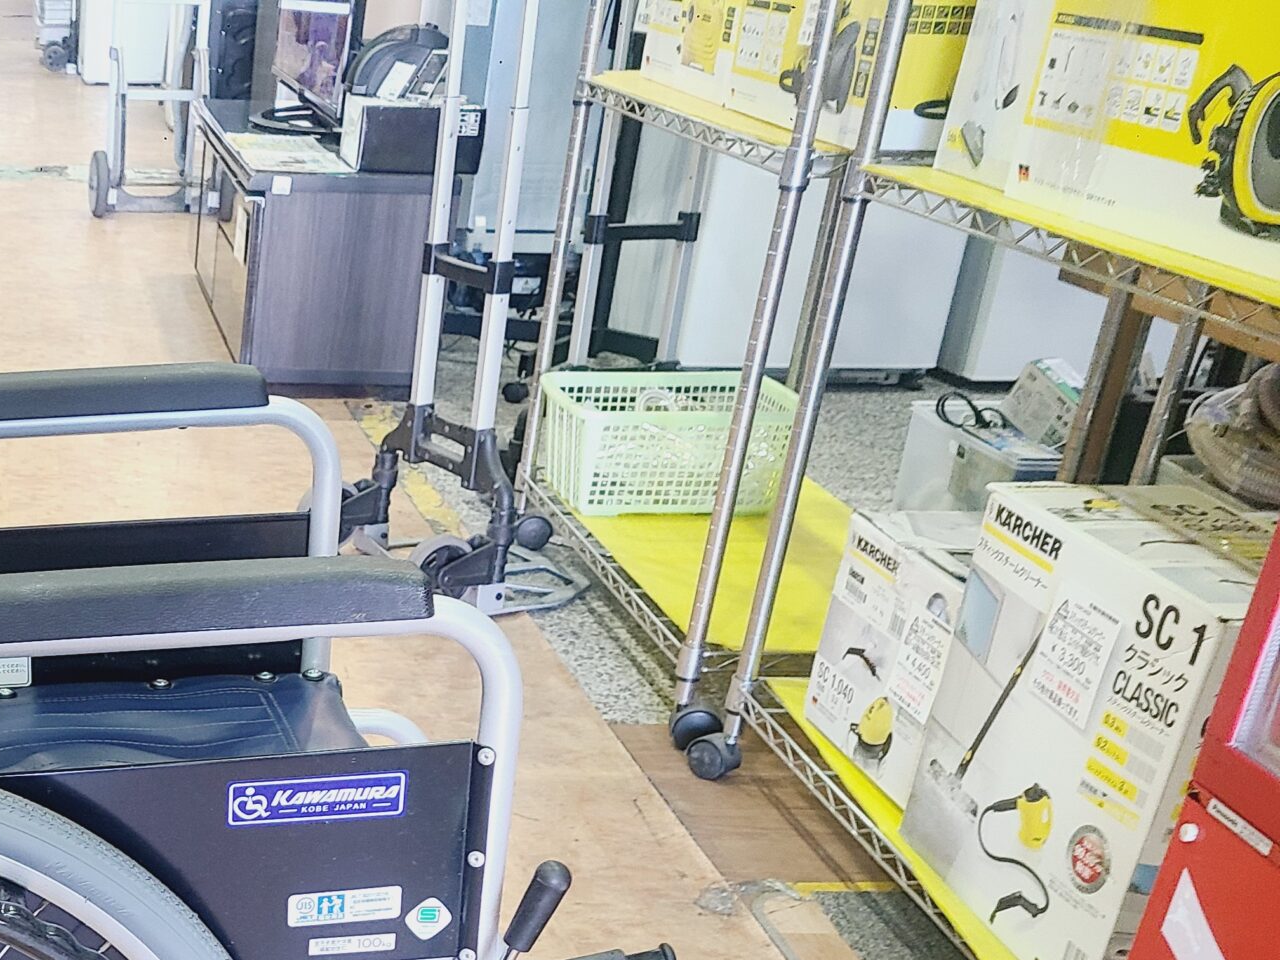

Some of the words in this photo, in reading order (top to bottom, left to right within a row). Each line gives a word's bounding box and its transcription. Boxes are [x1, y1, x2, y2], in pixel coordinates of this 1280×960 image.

[1135, 593, 1180, 651] SC
[1189, 624, 1207, 666] 1
[1124, 643, 1189, 693] クラシック
[1112, 670, 1179, 728] CLASSIC
[271, 784, 401, 807] KAWAMURA
[301, 804, 329, 813] KOBE
[333, 802, 367, 811] JAPAN
